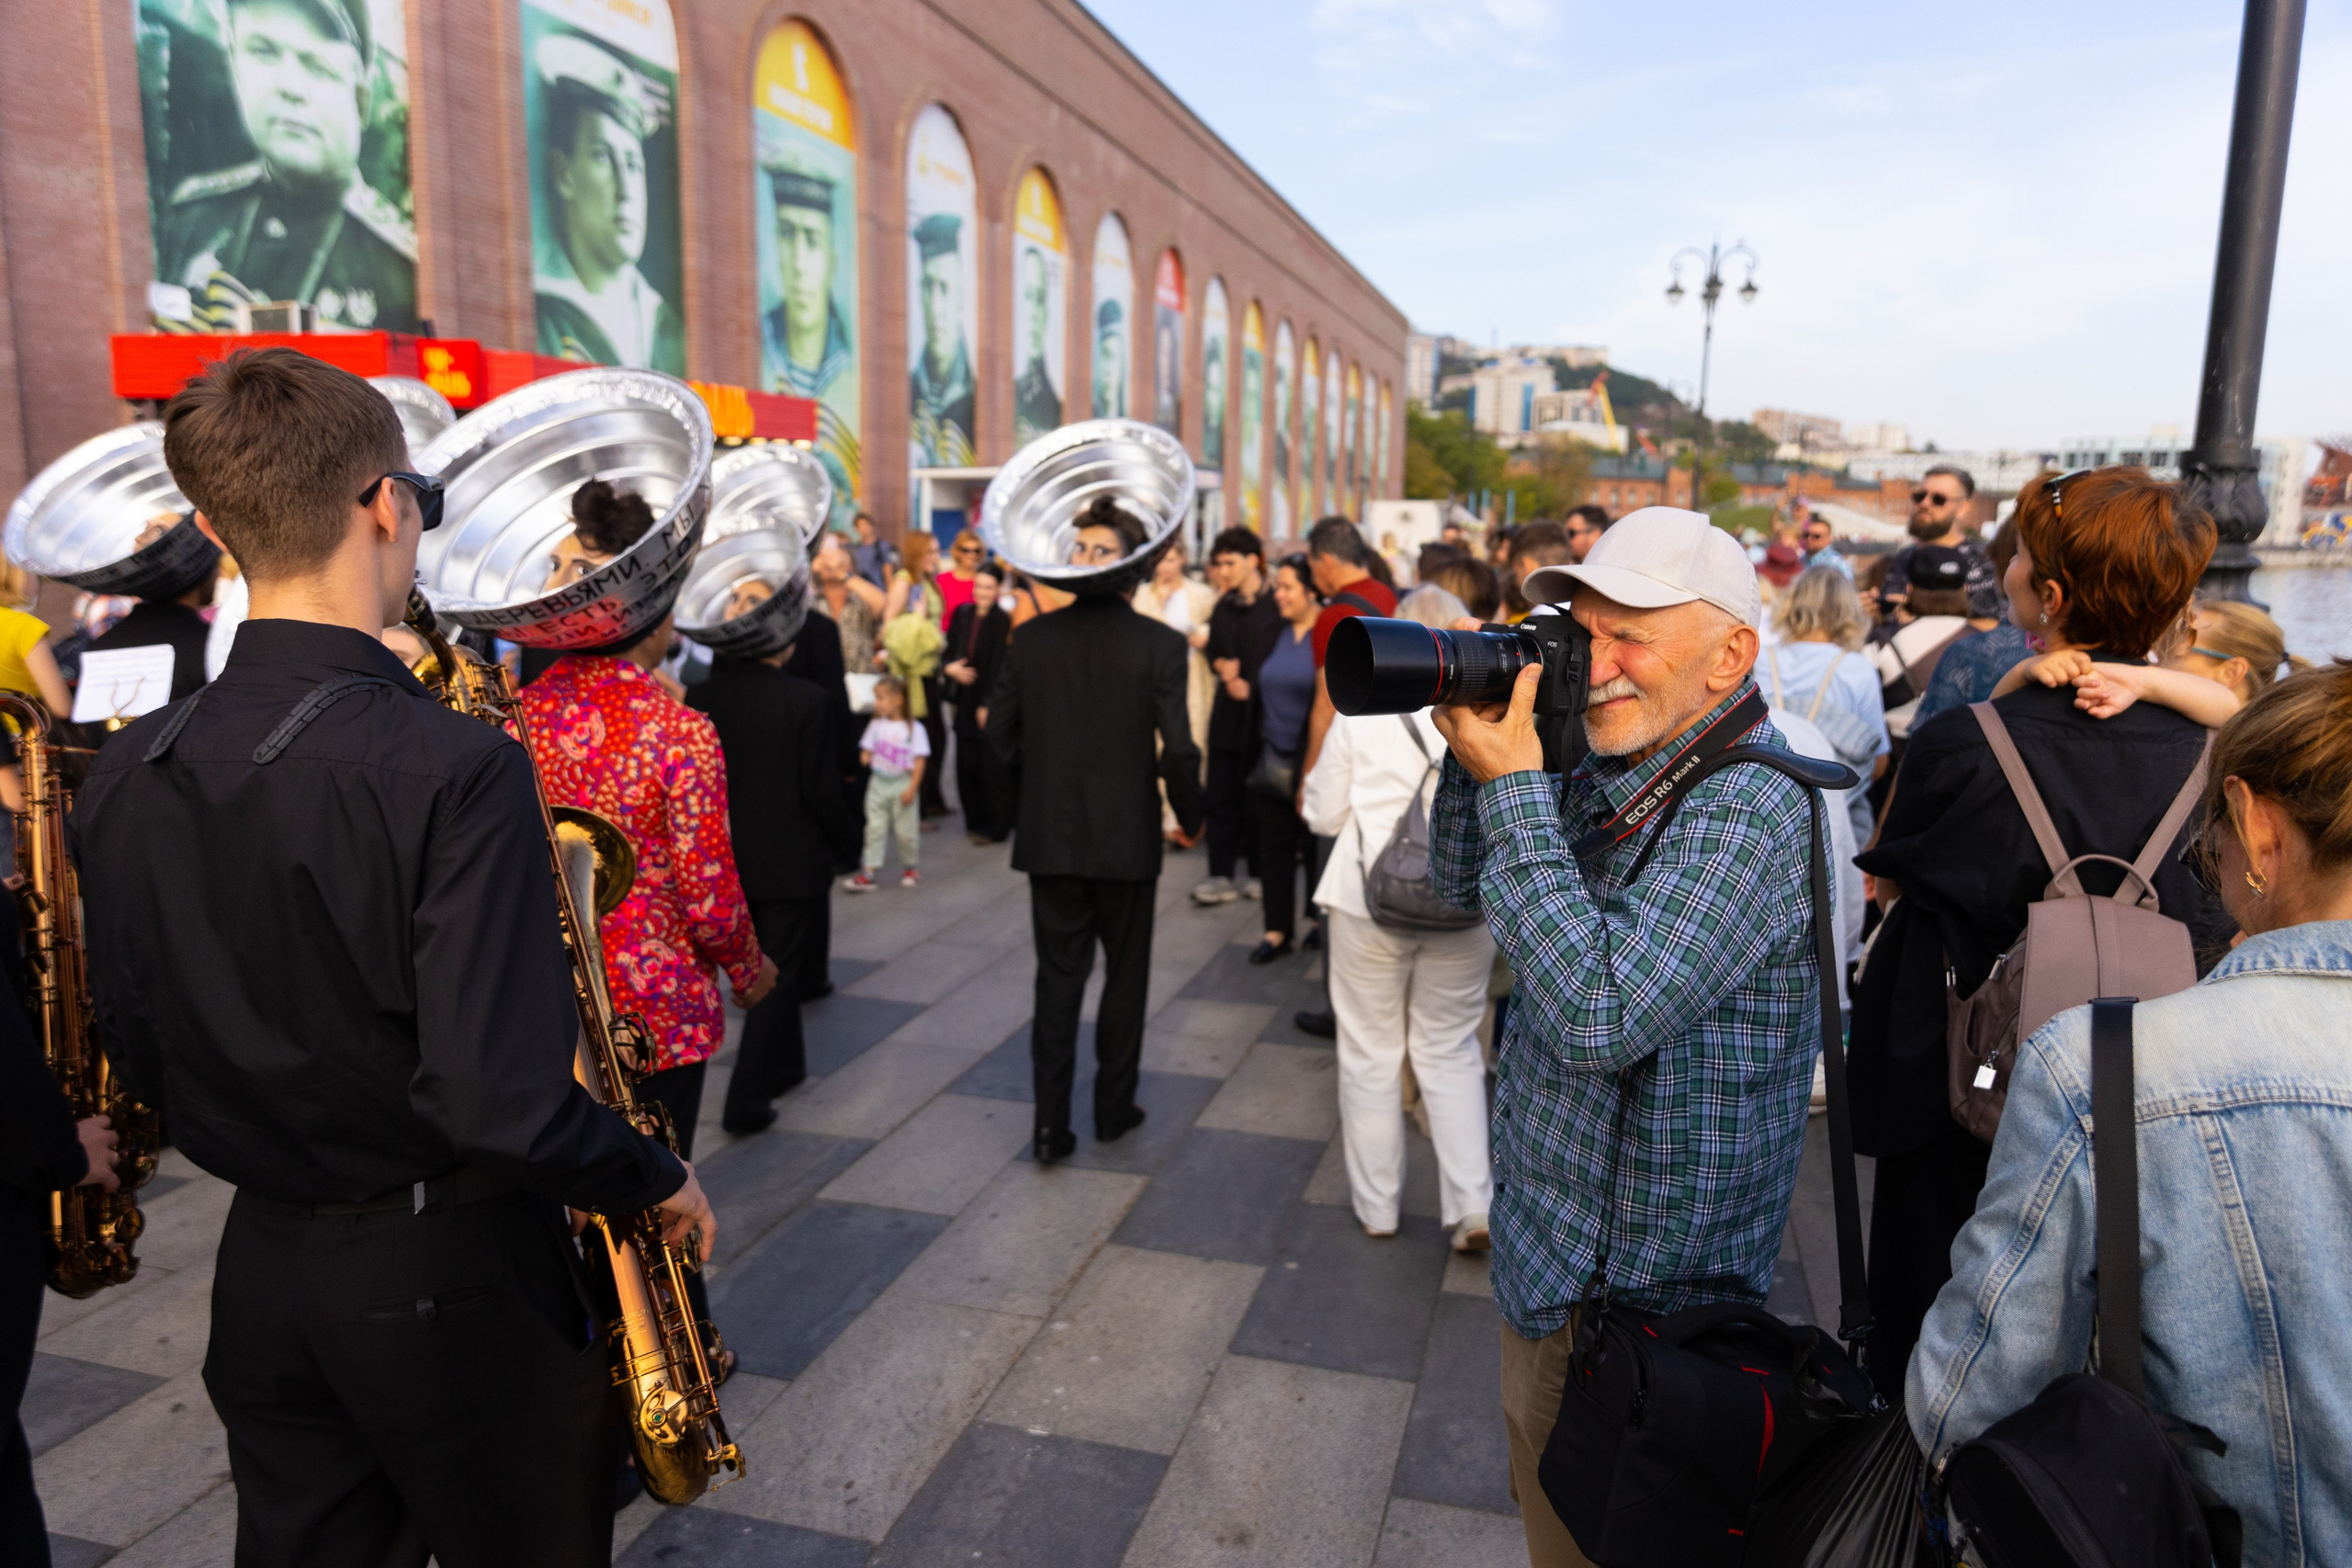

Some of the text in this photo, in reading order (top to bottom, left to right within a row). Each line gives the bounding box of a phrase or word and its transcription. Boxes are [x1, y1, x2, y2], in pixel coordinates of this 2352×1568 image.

[539, 599, 617, 634] ЕСТЬ
[639, 536, 693, 592] ЭТО
[1625, 795, 1657, 825] EOS
[1654, 779, 1673, 798] R6
[1672, 761, 1695, 782] Mark
